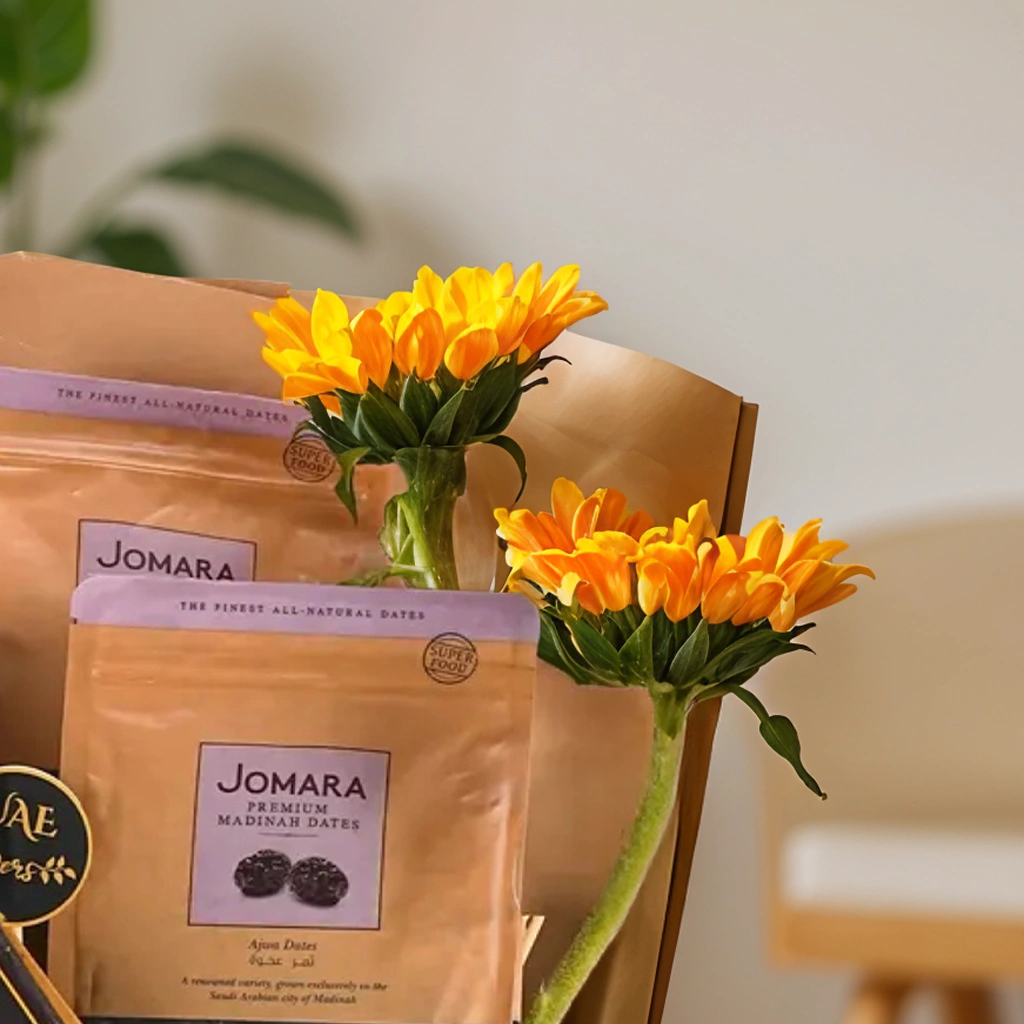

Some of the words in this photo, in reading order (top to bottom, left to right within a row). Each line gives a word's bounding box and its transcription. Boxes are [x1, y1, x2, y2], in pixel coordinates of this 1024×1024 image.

[57, 388, 82, 400] THE
[90, 392, 137, 405] FINEST
[144, 398, 238, 417] ALL-NATURAL
[246, 409, 289, 423] DATES
[291, 457, 326, 473] FOOD
[96, 540, 235, 580] JOMARA
[180, 601, 206, 612] THE
[214, 602, 265, 614] FINEST
[272, 606, 373, 619] ALL-NATURAL
[380, 609, 426, 621] DATES
[430, 645, 474, 664] SUPER
[430, 658, 468, 673] FOOD
[217, 762, 368, 800] JOMARA
[247, 801, 329, 815] PREMIUM
[217, 814, 301, 829] MADINAH
[308, 817, 361, 831] DATES
[283, 938, 318, 951] Dates
[314, 993, 357, 1004] Madinah
